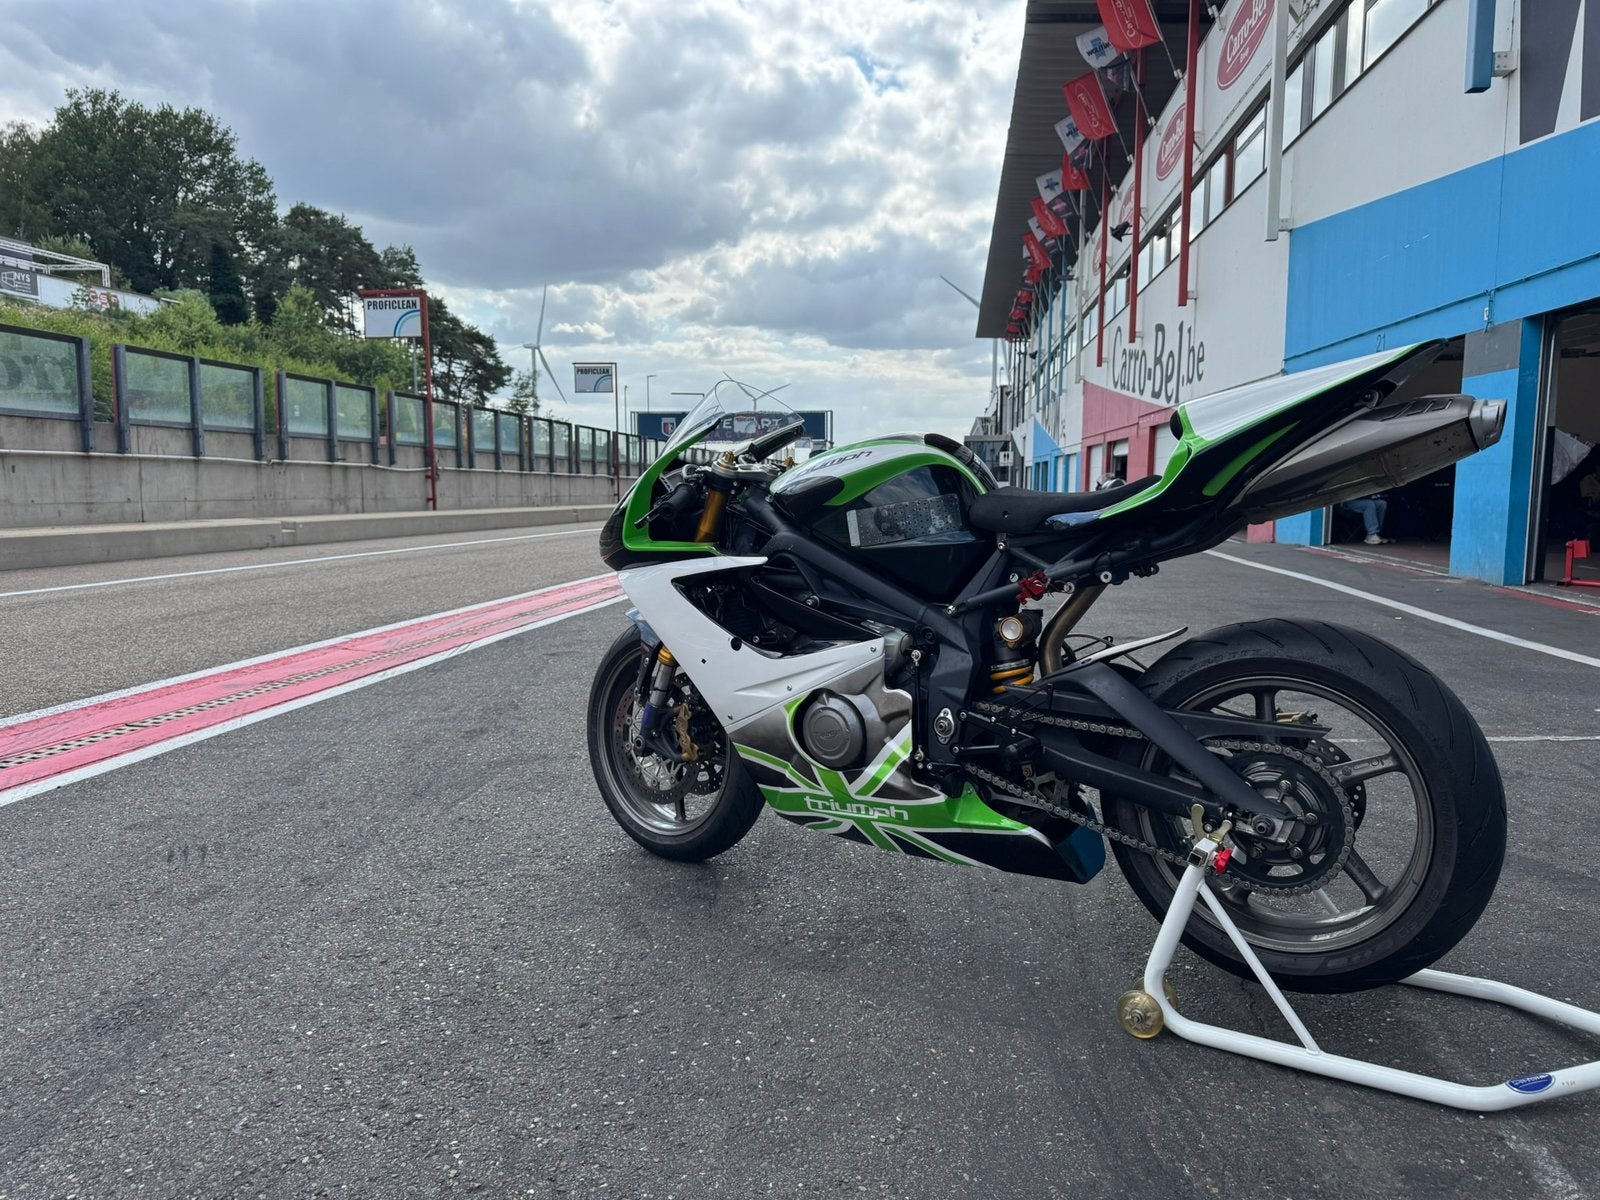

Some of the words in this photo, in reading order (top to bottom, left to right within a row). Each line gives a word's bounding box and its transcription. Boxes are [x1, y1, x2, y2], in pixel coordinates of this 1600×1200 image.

[14, 271, 31, 283] NYS
[366, 299, 418, 311] PROFICLEAN
[1112, 320, 1205, 404] Carro-Bel.be
[576, 367, 610, 375] PROFICLEAN
[803, 795, 910, 821] triumph
